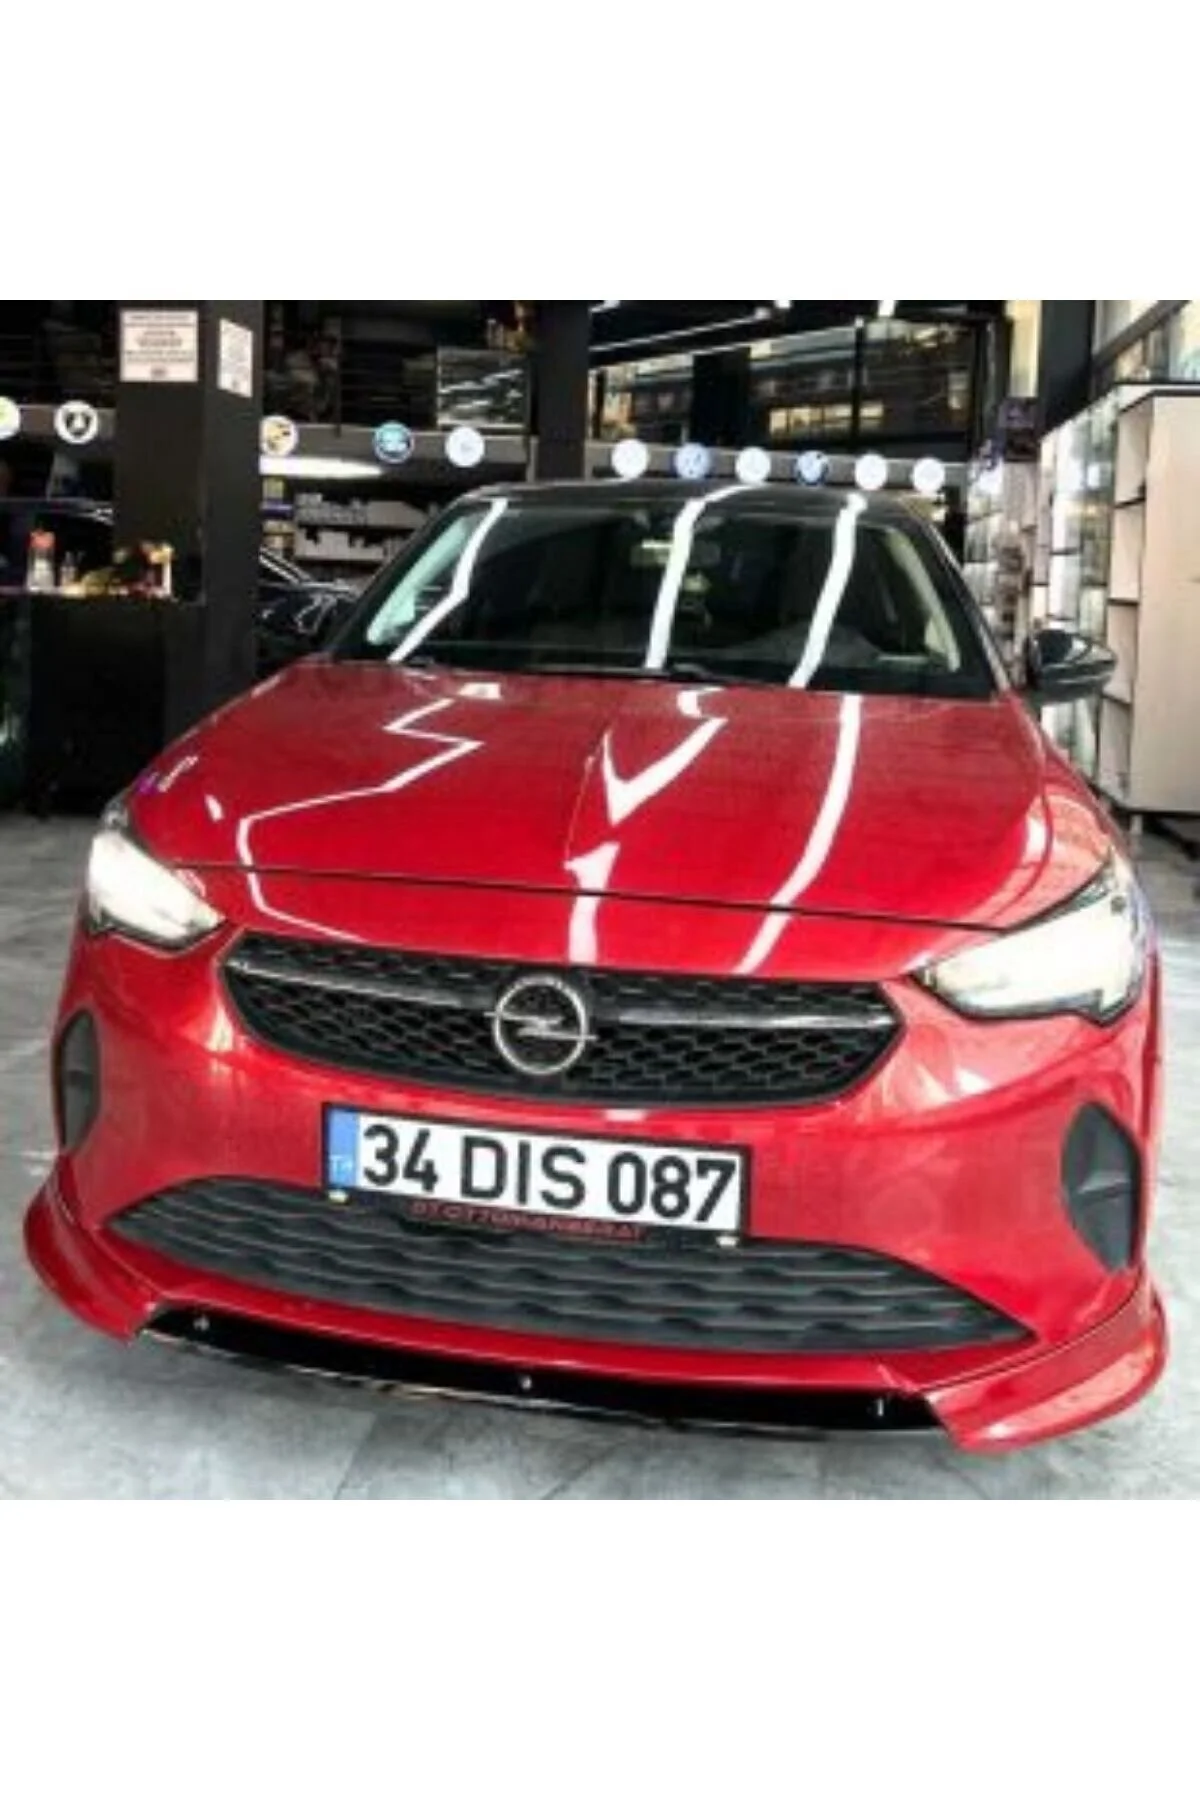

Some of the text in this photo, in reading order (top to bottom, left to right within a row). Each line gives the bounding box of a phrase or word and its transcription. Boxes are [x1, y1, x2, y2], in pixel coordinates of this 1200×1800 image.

[363, 1124, 737, 1223] 34 DIS 087
